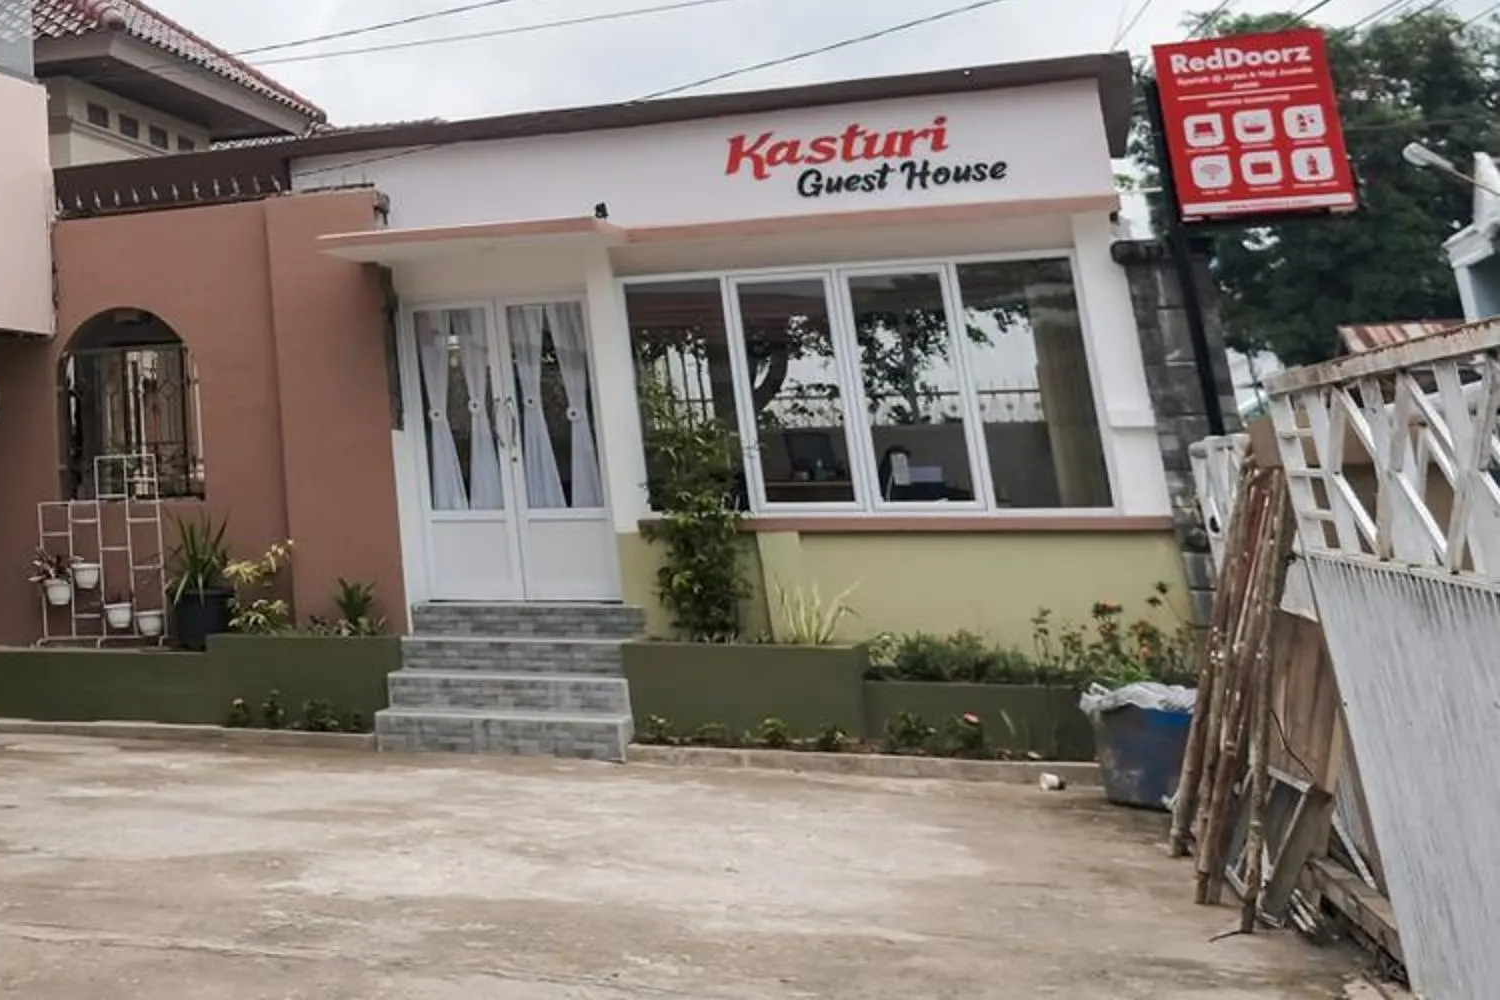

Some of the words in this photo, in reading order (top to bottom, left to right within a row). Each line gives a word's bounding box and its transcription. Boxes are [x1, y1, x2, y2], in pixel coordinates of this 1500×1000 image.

[1169, 45, 1313, 75] RedDoorz
[724, 116, 948, 180] Kasturi
[797, 162, 895, 197] Guest
[900, 159, 1008, 190] House
